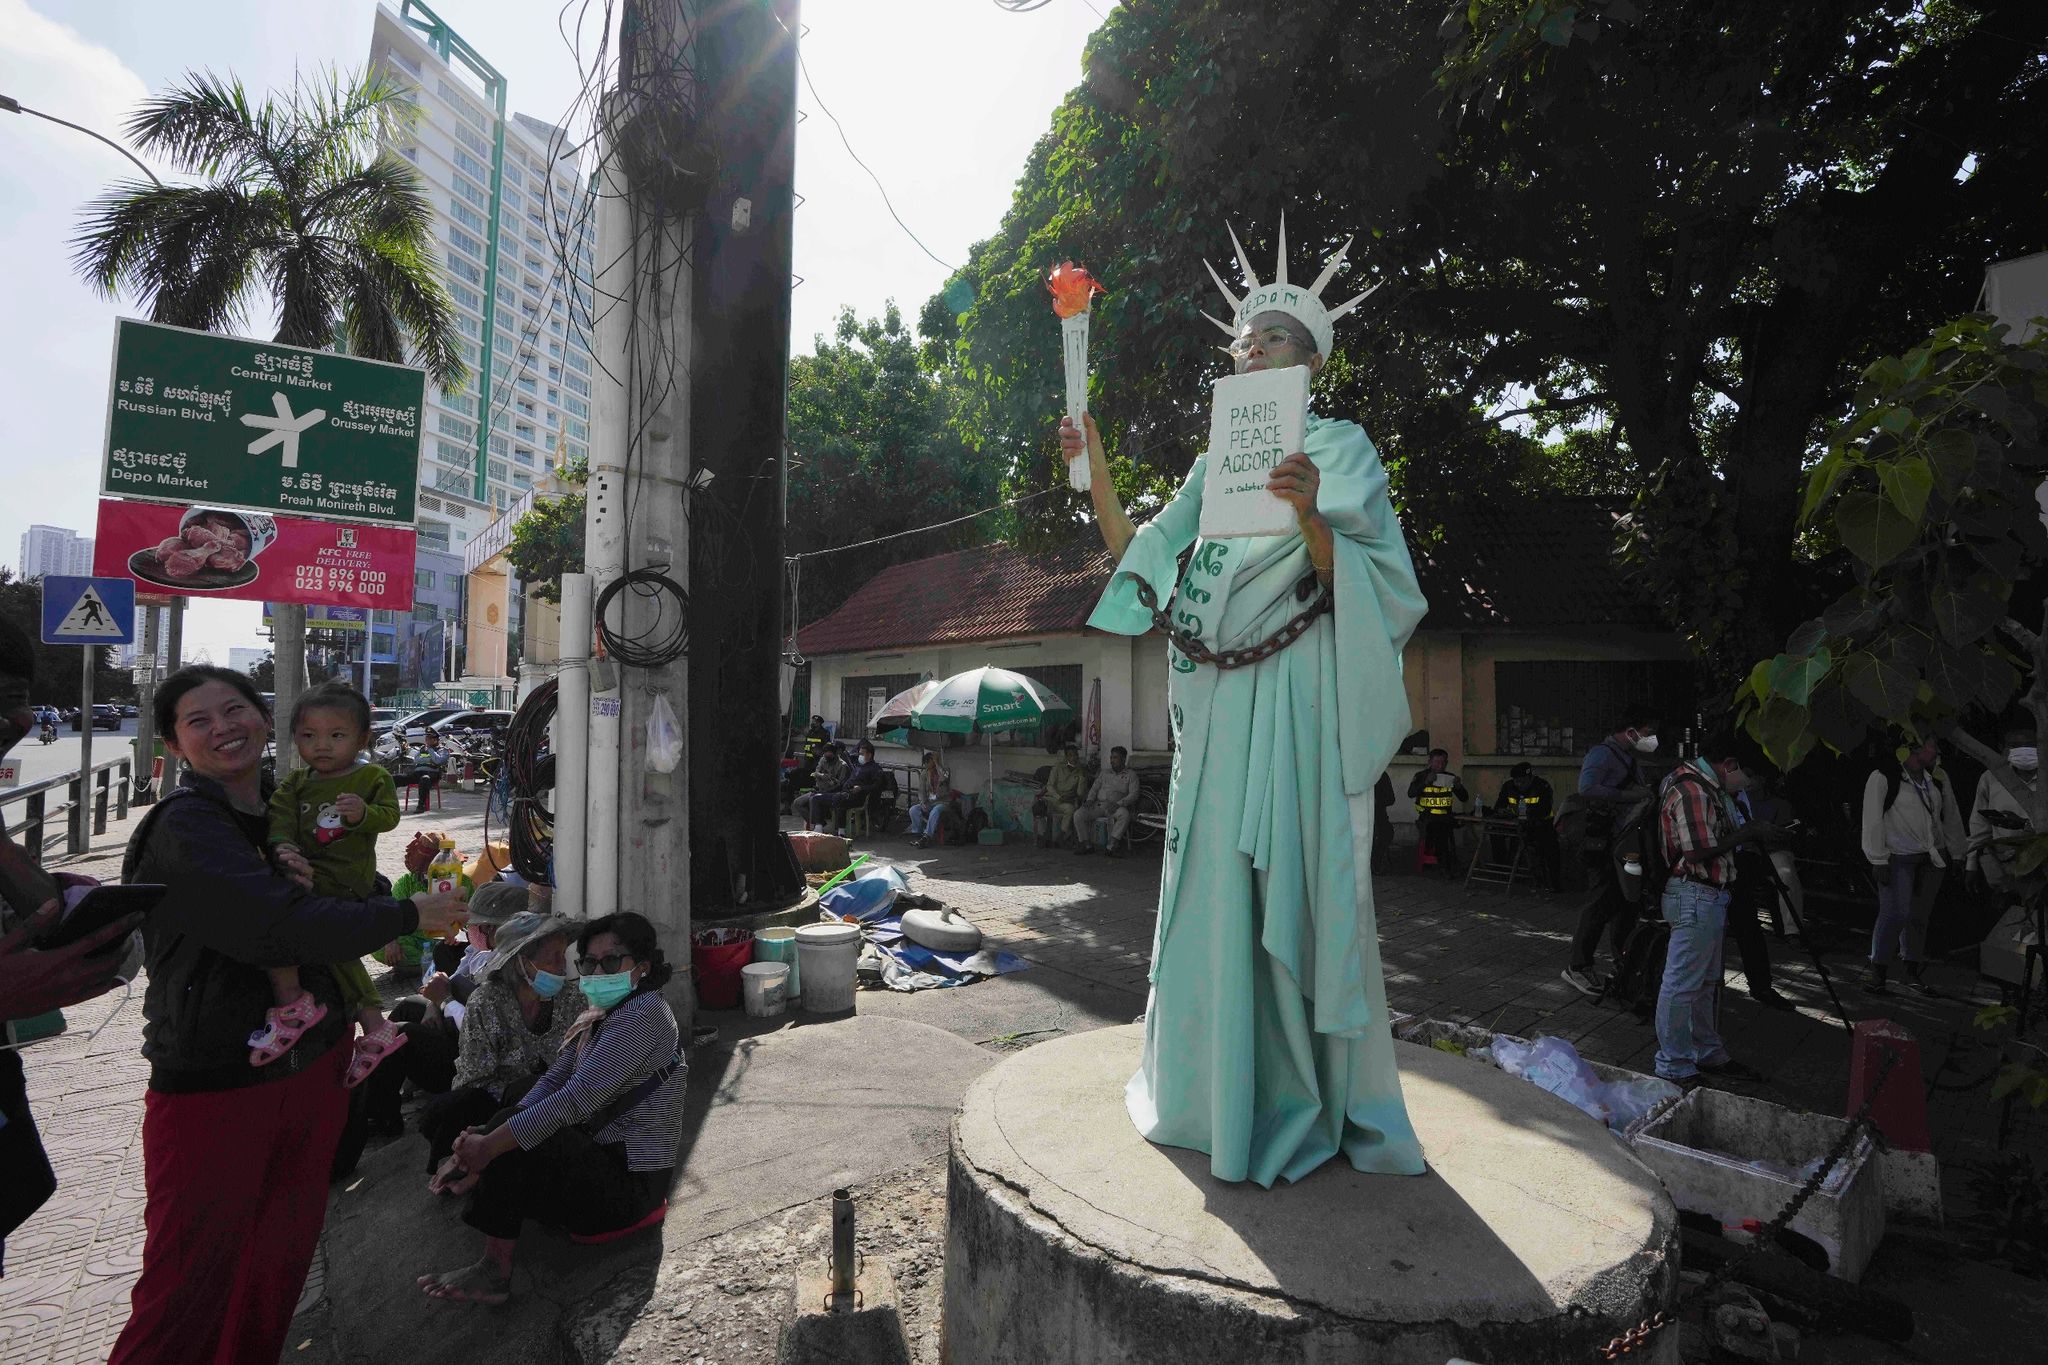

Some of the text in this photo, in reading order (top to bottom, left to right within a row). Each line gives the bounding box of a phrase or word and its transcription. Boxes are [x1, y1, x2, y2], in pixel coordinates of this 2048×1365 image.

[231, 366, 333, 391] Central Market
[117, 399, 216, 423] Russian Blvd.
[1230, 401, 1277, 427] PARIS
[331, 417, 415, 438] Orussey Market
[1230, 424, 1282, 450] PEACE
[111, 467, 209, 489] Depo Market
[280, 493, 396, 515] Preah Monireth Blvd.
[318, 547, 372, 560] KFC FREE
[296, 565, 387, 583] 070 896 000
[295, 577, 385, 595] 023 996 000
[983, 701, 1022, 713] Smart
[1425, 798, 1450, 806] POLICE
